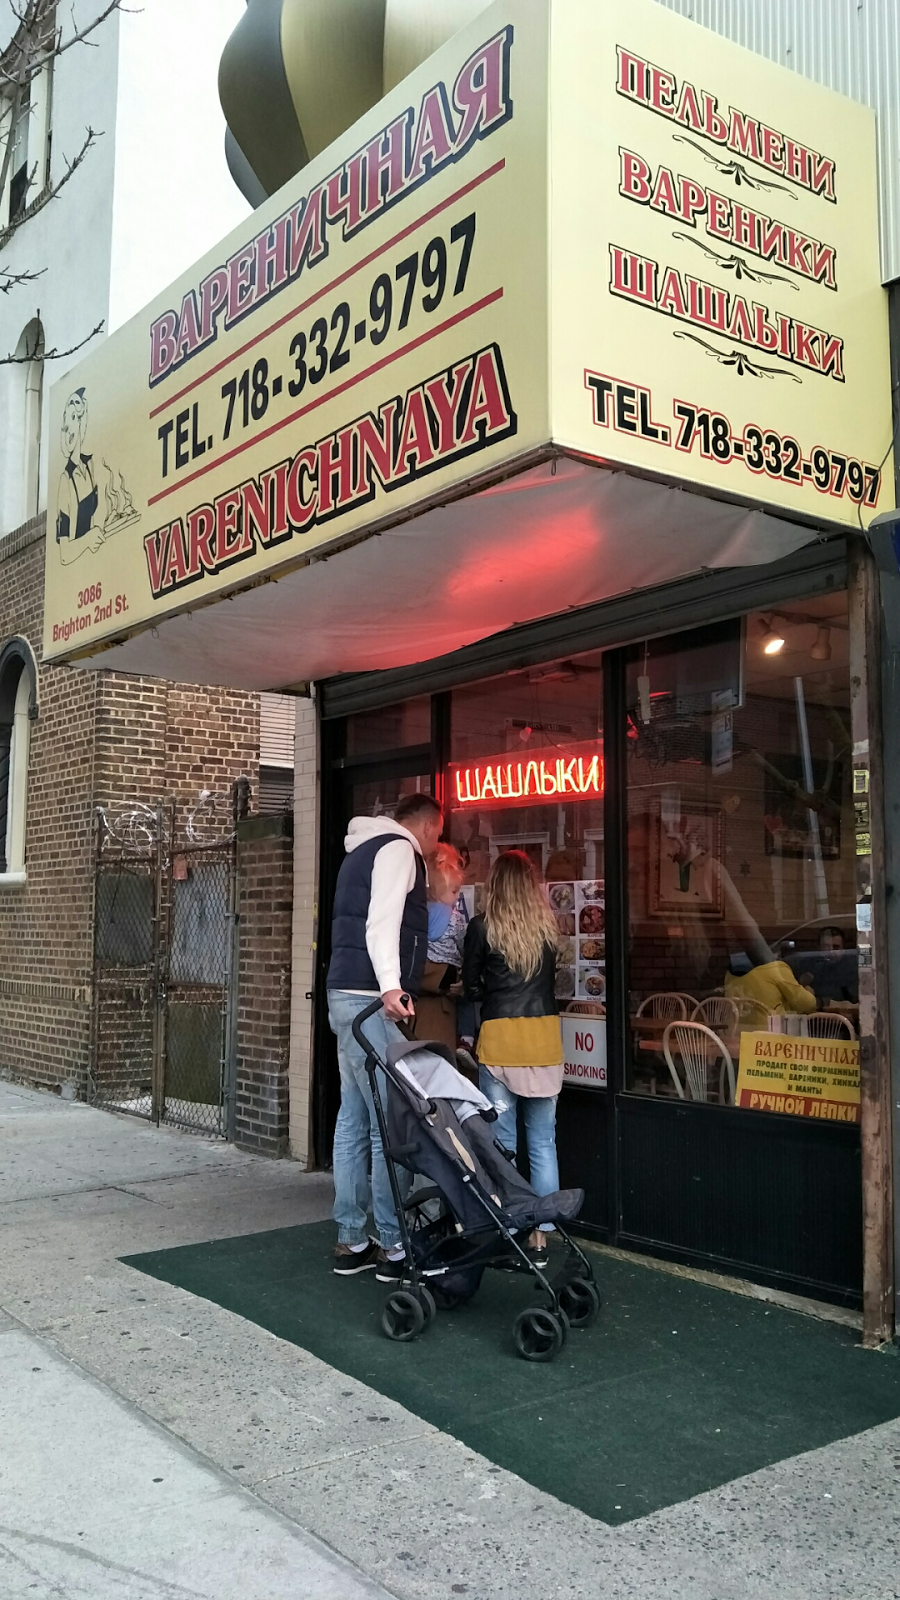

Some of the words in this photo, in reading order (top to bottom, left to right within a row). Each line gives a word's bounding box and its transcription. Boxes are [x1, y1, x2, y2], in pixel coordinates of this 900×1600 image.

[615, 43, 837, 204] ПЕЛЬМЕНИ
[148, 23, 514, 389] ВАРЕНИЧНАЯ
[618, 146, 838, 291] ВАРЕНИКИ
[608, 243, 846, 383] ШАШЛЫКИ
[158, 401, 213, 478] TEL.
[221, 212, 477, 441] 718-332-9797
[584, 368, 671, 446] TEL.
[673, 397, 882, 508] 718-332-9797
[143, 342, 518, 600] VARENICHNAYA
[53, 613, 91, 642] Brighton
[94, 599, 112, 624] 2nd
[115, 594, 129, 615] St.
[77, 581, 102, 609] 3086
[456, 755, 599, 802] ШАШЛЫКИ
[575, 1032, 594, 1052] NO
[754, 1040, 860, 1065] ВАРЕНИЧНАЯ
[564, 1062, 606, 1080] SMOKING
[756, 1060, 787, 1070] ПРОДАЕТ
[811, 1065, 858, 1077] ФИРМЕННЫЕ
[795, 1085, 822, 1095] МАНТЫ
[750, 1093, 805, 1116] РУЧНОЙ
[809, 1101, 857, 1122] ЛЕПКИ
